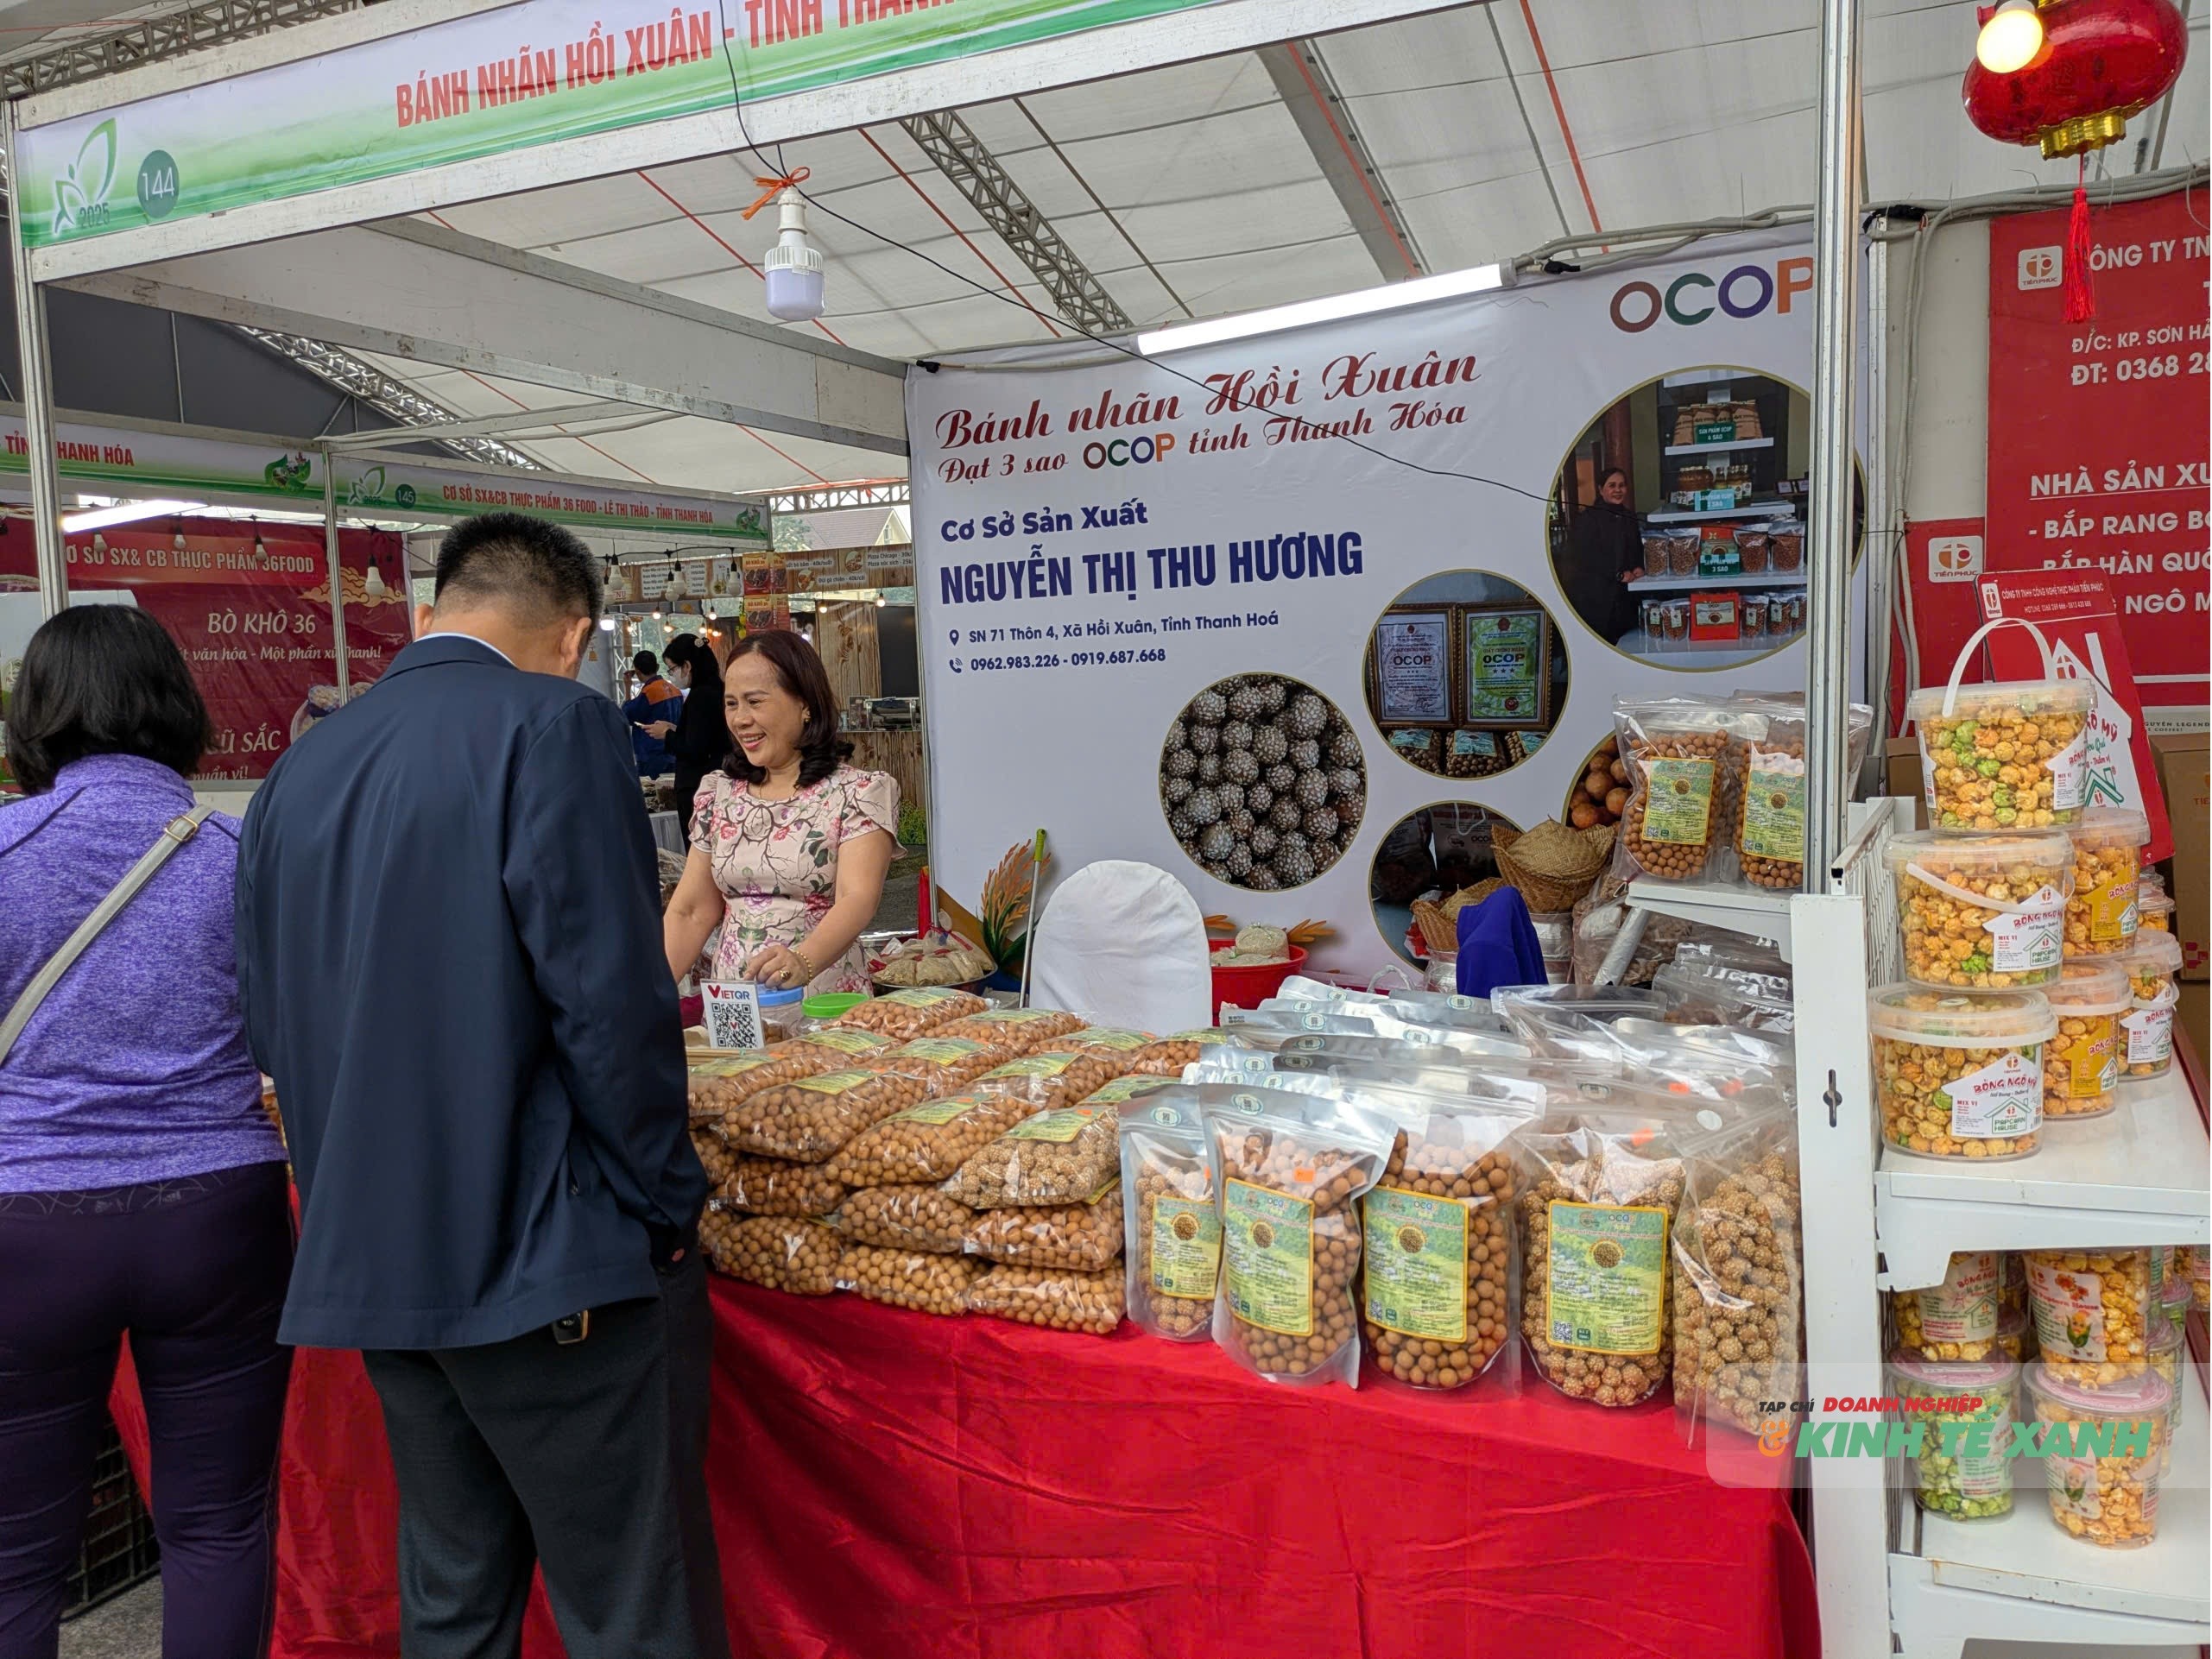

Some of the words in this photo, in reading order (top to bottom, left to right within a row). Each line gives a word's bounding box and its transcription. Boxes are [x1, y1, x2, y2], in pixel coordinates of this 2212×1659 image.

[395, 70, 470, 129] BÁNH
[477, 44, 558, 110] NHÃN
[566, 21, 616, 90] HỒI
[624, 7, 712, 77] XUÂN
[142, 167, 175, 201] 144
[79, 202, 111, 230] 2025
[2089, 243, 2143, 271] ÔNG
[2149, 240, 2176, 263] TY
[1609, 256, 1814, 333] OCOP
[2118, 331, 2141, 348] KP.
[2146, 325, 2183, 345] SƠN
[2071, 363, 2108, 386] ĐT:
[2116, 355, 2179, 382] 0368
[935, 399, 1054, 450] Bánh
[1067, 389, 1185, 433] nhãn
[1203, 365, 1304, 415] Hồi
[1322, 350, 1482, 401] Xuân
[5, 431, 29, 456] TỈN
[56, 441, 101, 464] HANH
[103, 444, 135, 467] HÓA
[938, 457, 993, 484] Đạt
[999, 454, 1016, 476] 3
[1023, 452, 1069, 474] sao
[1083, 432, 1176, 470] OCOP
[1188, 423, 1251, 455] tỉnh
[1263, 407, 1375, 446] Thanh
[1387, 400, 1469, 431] Hóa
[2030, 465, 2095, 497] NHÀ
[2103, 460, 2165, 492] SẢN
[398, 489, 414, 504] 145
[475, 489, 508, 505] SX&CB
[563, 497, 574, 512] 36
[575, 499, 597, 514] FOOD
[674, 508, 698, 523] THANH
[940, 518, 976, 542] Cơ
[982, 510, 1016, 539] Sở
[1022, 506, 1074, 535] Sản
[1081, 497, 1149, 529] Xuất
[2044, 509, 2095, 539] BẮP
[2102, 512, 2179, 536] RANG
[146, 549, 167, 567] CB
[171, 549, 212, 572] THỰC
[262, 554, 315, 574] 36FOOD
[940, 544, 1073, 604] NGUYỄN
[1082, 551, 1138, 601] THỊ
[1147, 544, 1217, 590] THU
[1229, 531, 1364, 583] HƯƠNG
[2126, 588, 2192, 615] NGÔ
[207, 608, 237, 634] BÒ
[243, 609, 288, 635] KHÔ
[293, 614, 316, 634] 36
[969, 630, 987, 643] SN
[990, 628, 1005, 642] 71
[1009, 626, 1043, 641] Thôn
[1046, 625, 1059, 641] 4,
[1063, 624, 1083, 639] Xã
[1086, 618, 1111, 637] Hồi
[1114, 619, 1158, 636] Xuân,
[1161, 615, 1191, 633] Tỉnh
[1195, 614, 1242, 630] Thanh
[1246, 609, 1280, 628] Hoá
[345, 645, 382, 659] hanh!
[970, 653, 1060, 671] 0962.983.226
[1071, 648, 1166, 666] 0919.687.668
[1394, 654, 1433, 665] OCOP
[1482, 653, 1526, 665] OCOP
[241, 722, 281, 753] SẮC
